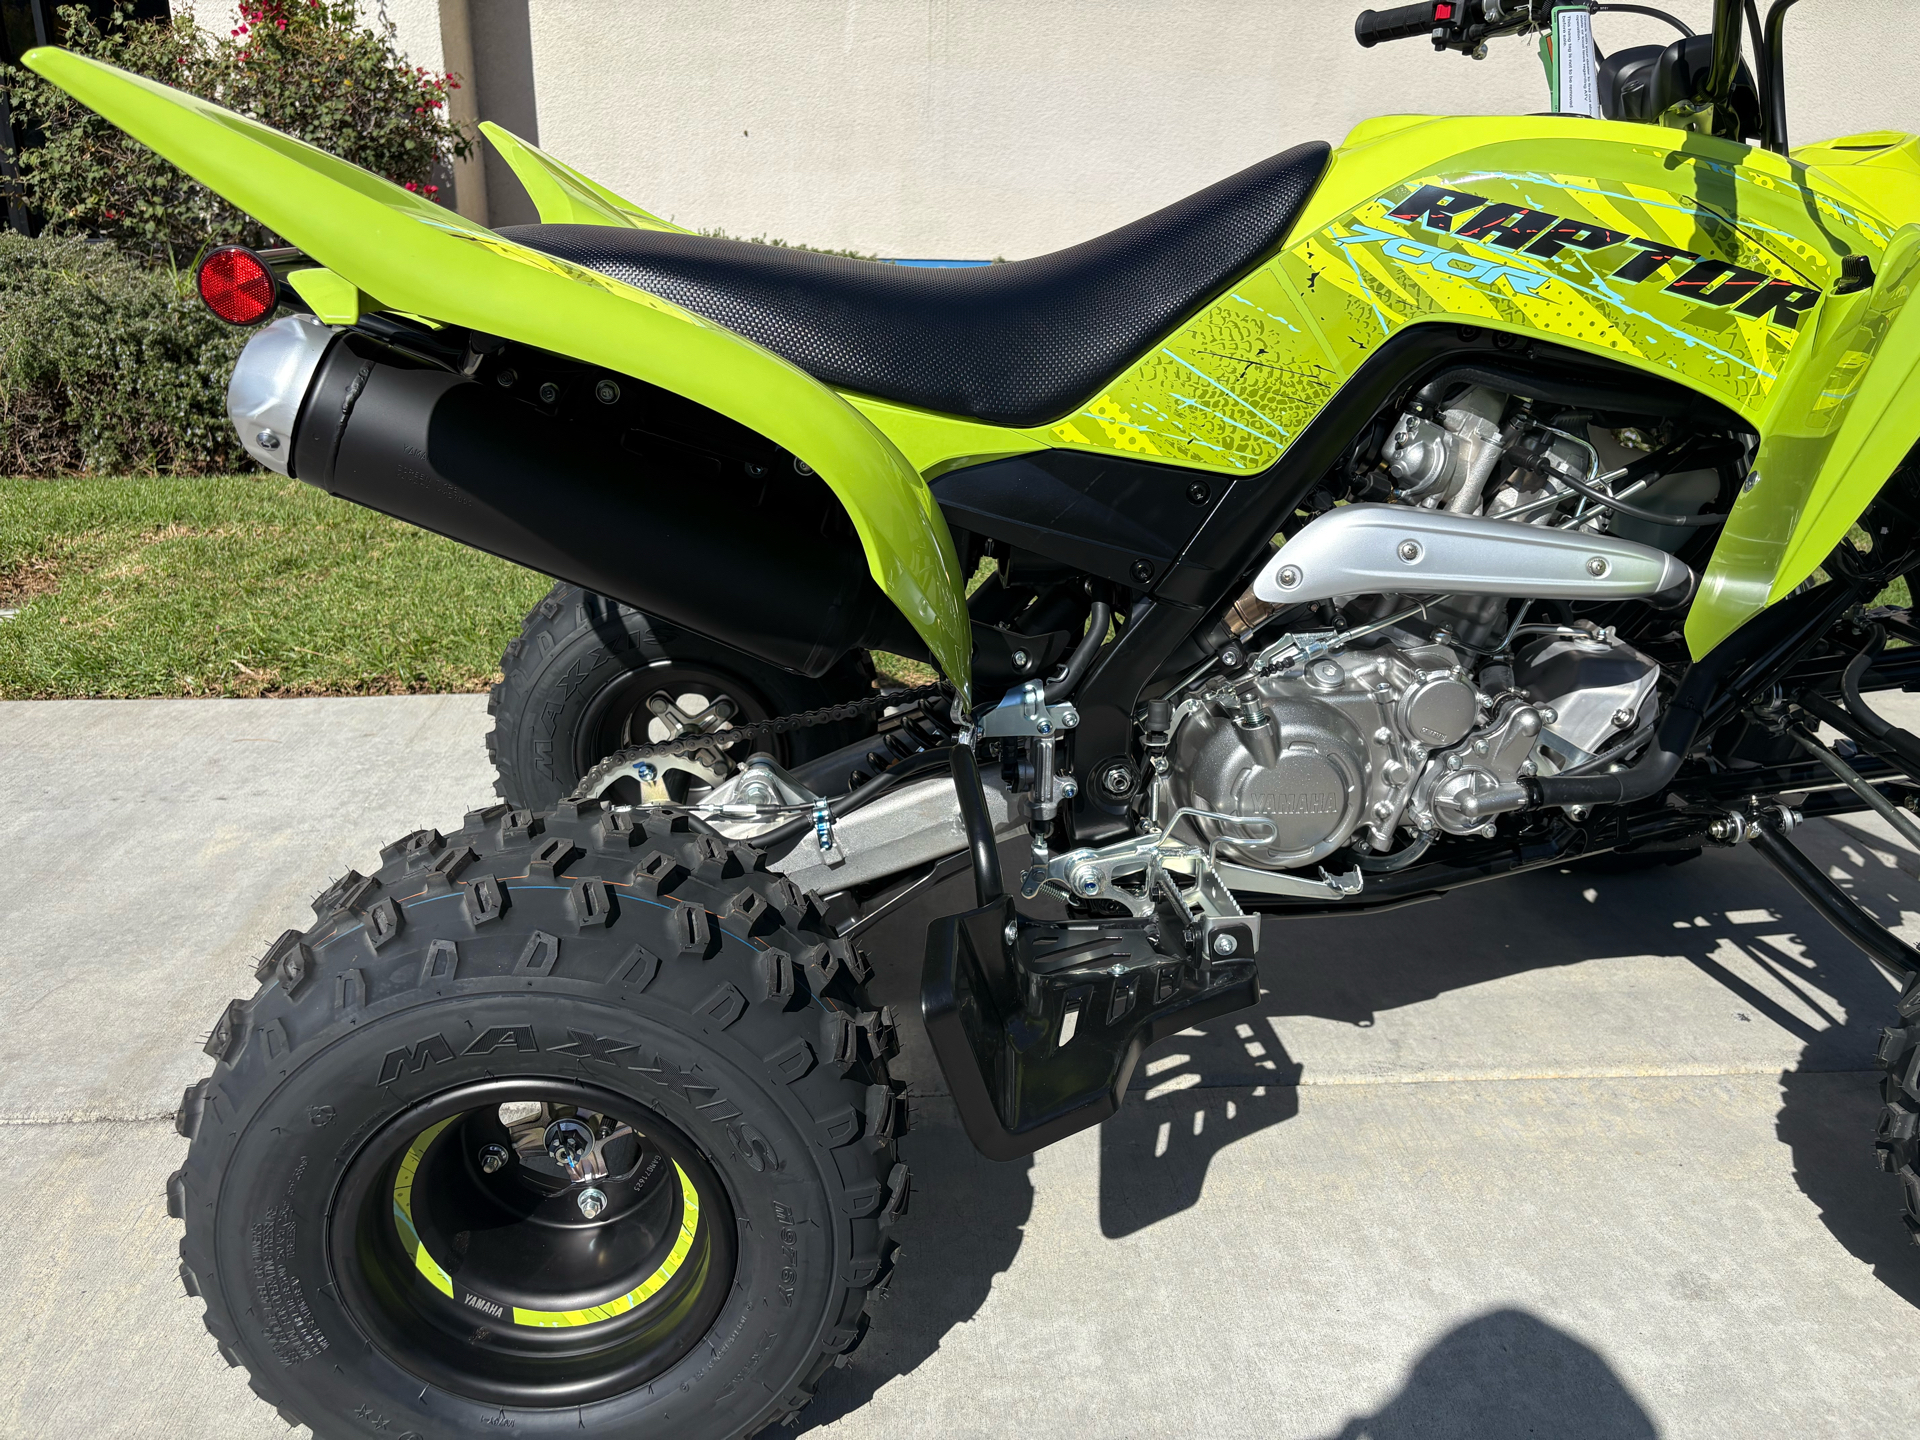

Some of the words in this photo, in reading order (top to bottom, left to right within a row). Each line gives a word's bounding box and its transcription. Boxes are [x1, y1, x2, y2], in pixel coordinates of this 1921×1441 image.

[1331, 223, 1561, 305] 700R
[1382, 184, 1822, 332] RAPTOR
[534, 627, 680, 782] MAXXIS
[1250, 793, 1338, 814] YAMAHA
[376, 1024, 780, 1172] MAXXIS
[464, 1293, 504, 1318] YAMAHA
[772, 1200, 798, 1308] M976Y
